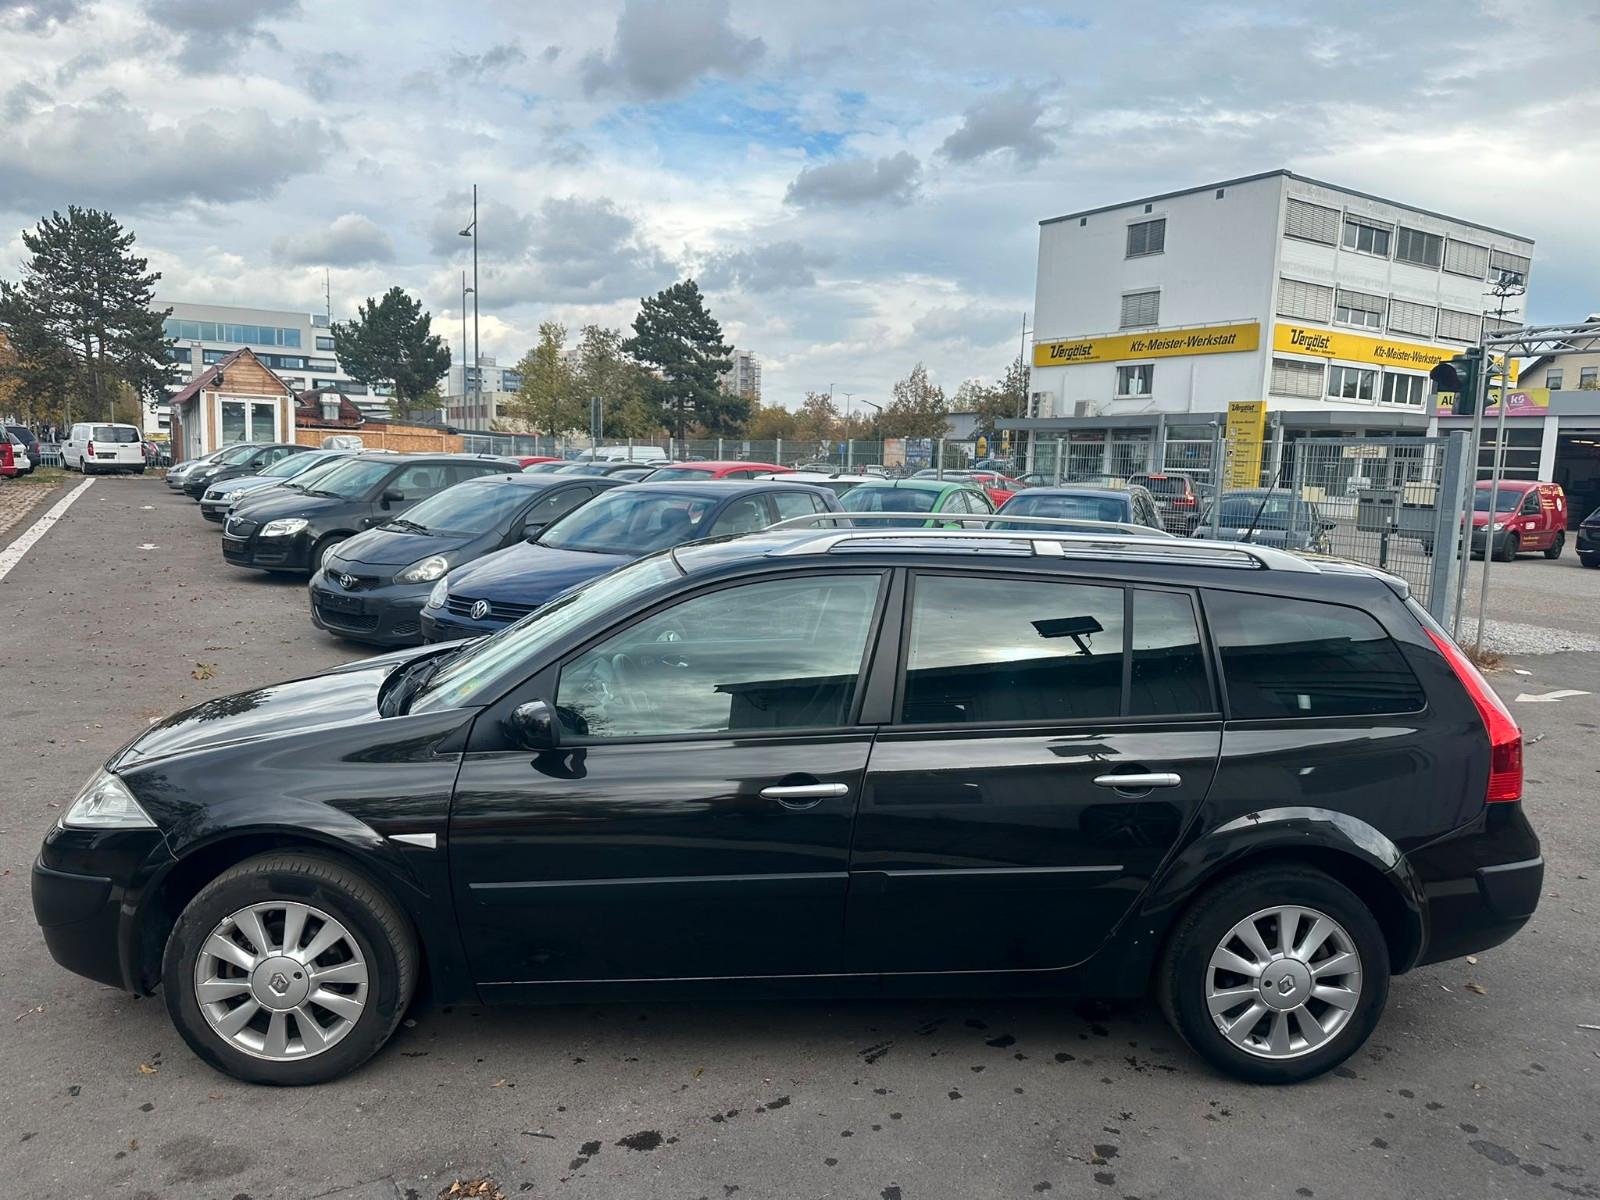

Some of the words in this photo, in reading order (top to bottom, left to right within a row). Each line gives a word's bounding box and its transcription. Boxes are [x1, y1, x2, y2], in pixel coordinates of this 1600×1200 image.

[1050, 343, 1093, 360] Vergölst
[1130, 333, 1236, 352] Kfz-Meister-Werkstatt
[1291, 329, 1330, 350] Vergölst
